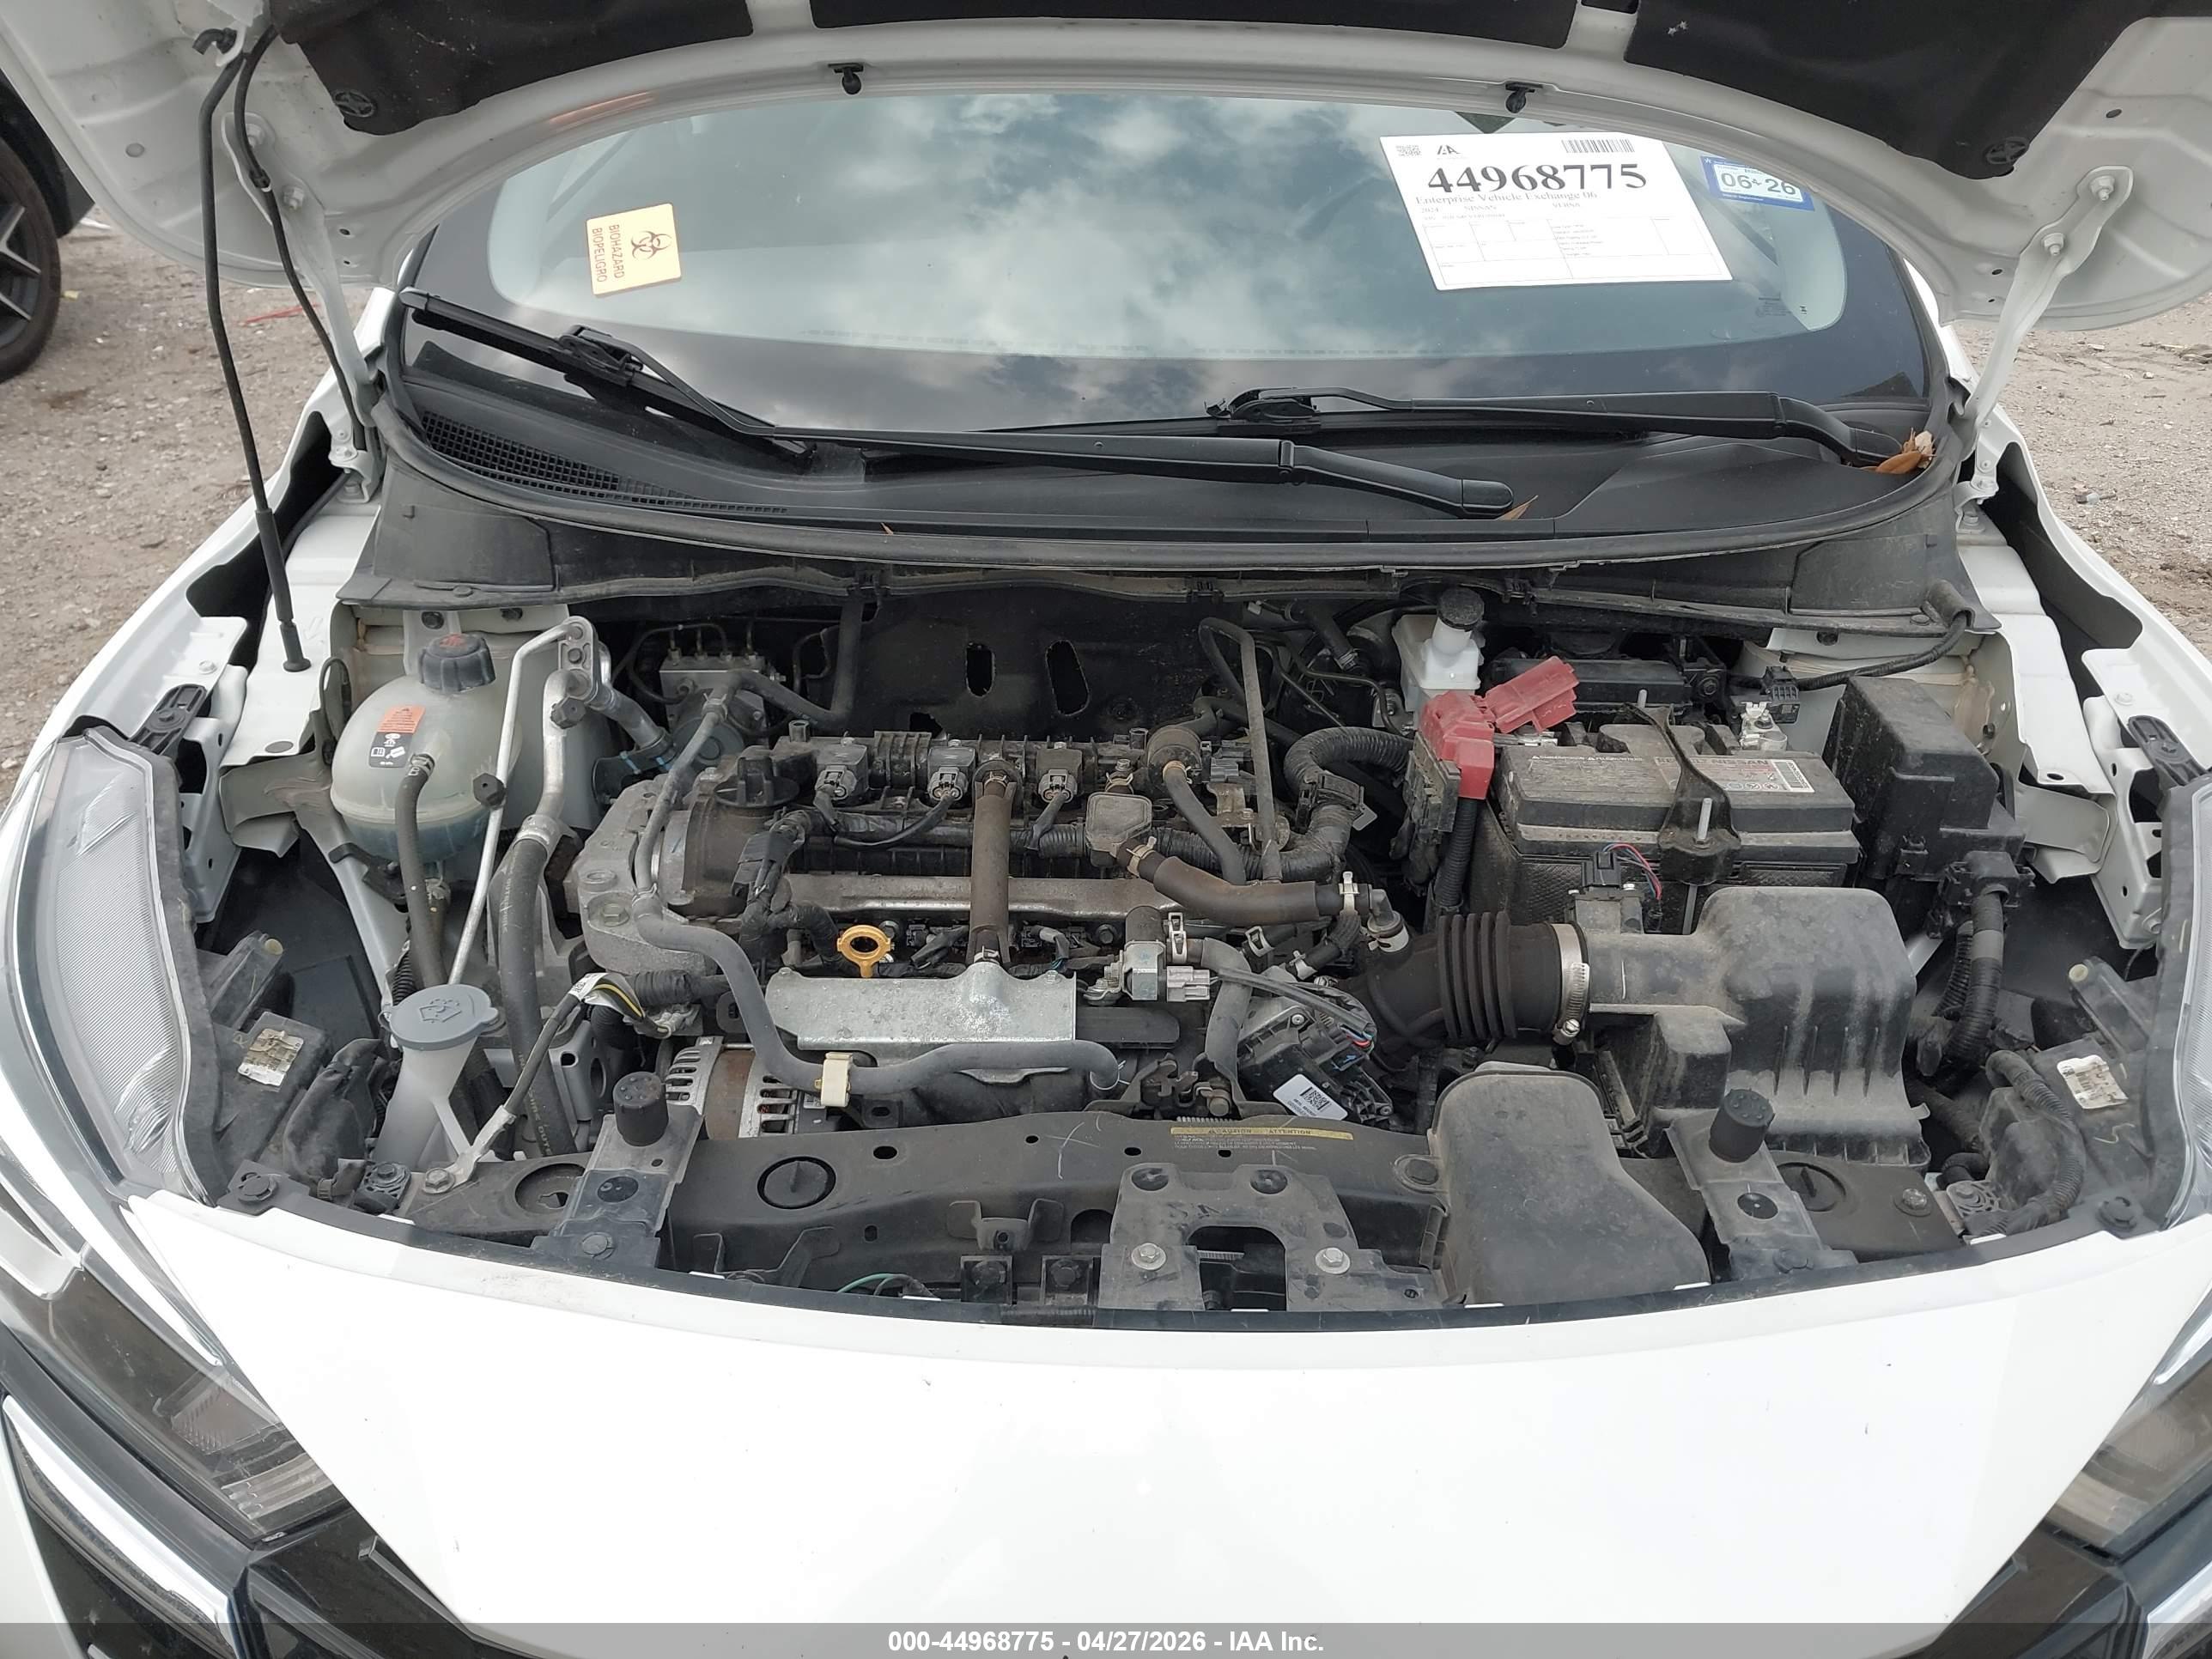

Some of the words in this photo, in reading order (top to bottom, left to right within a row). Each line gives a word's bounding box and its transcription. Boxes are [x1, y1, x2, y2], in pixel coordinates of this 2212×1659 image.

[1427, 163, 1647, 193] 44968775
[1721, 173, 1753, 189] 06
[1765, 179, 1796, 195] 26
[1415, 195, 1474, 205] Enterprise
[1525, 192, 1580, 201] Exchange
[592, 228, 607, 282] BIOPELIGRO
[609, 224, 624, 278] BIOHAZARD
